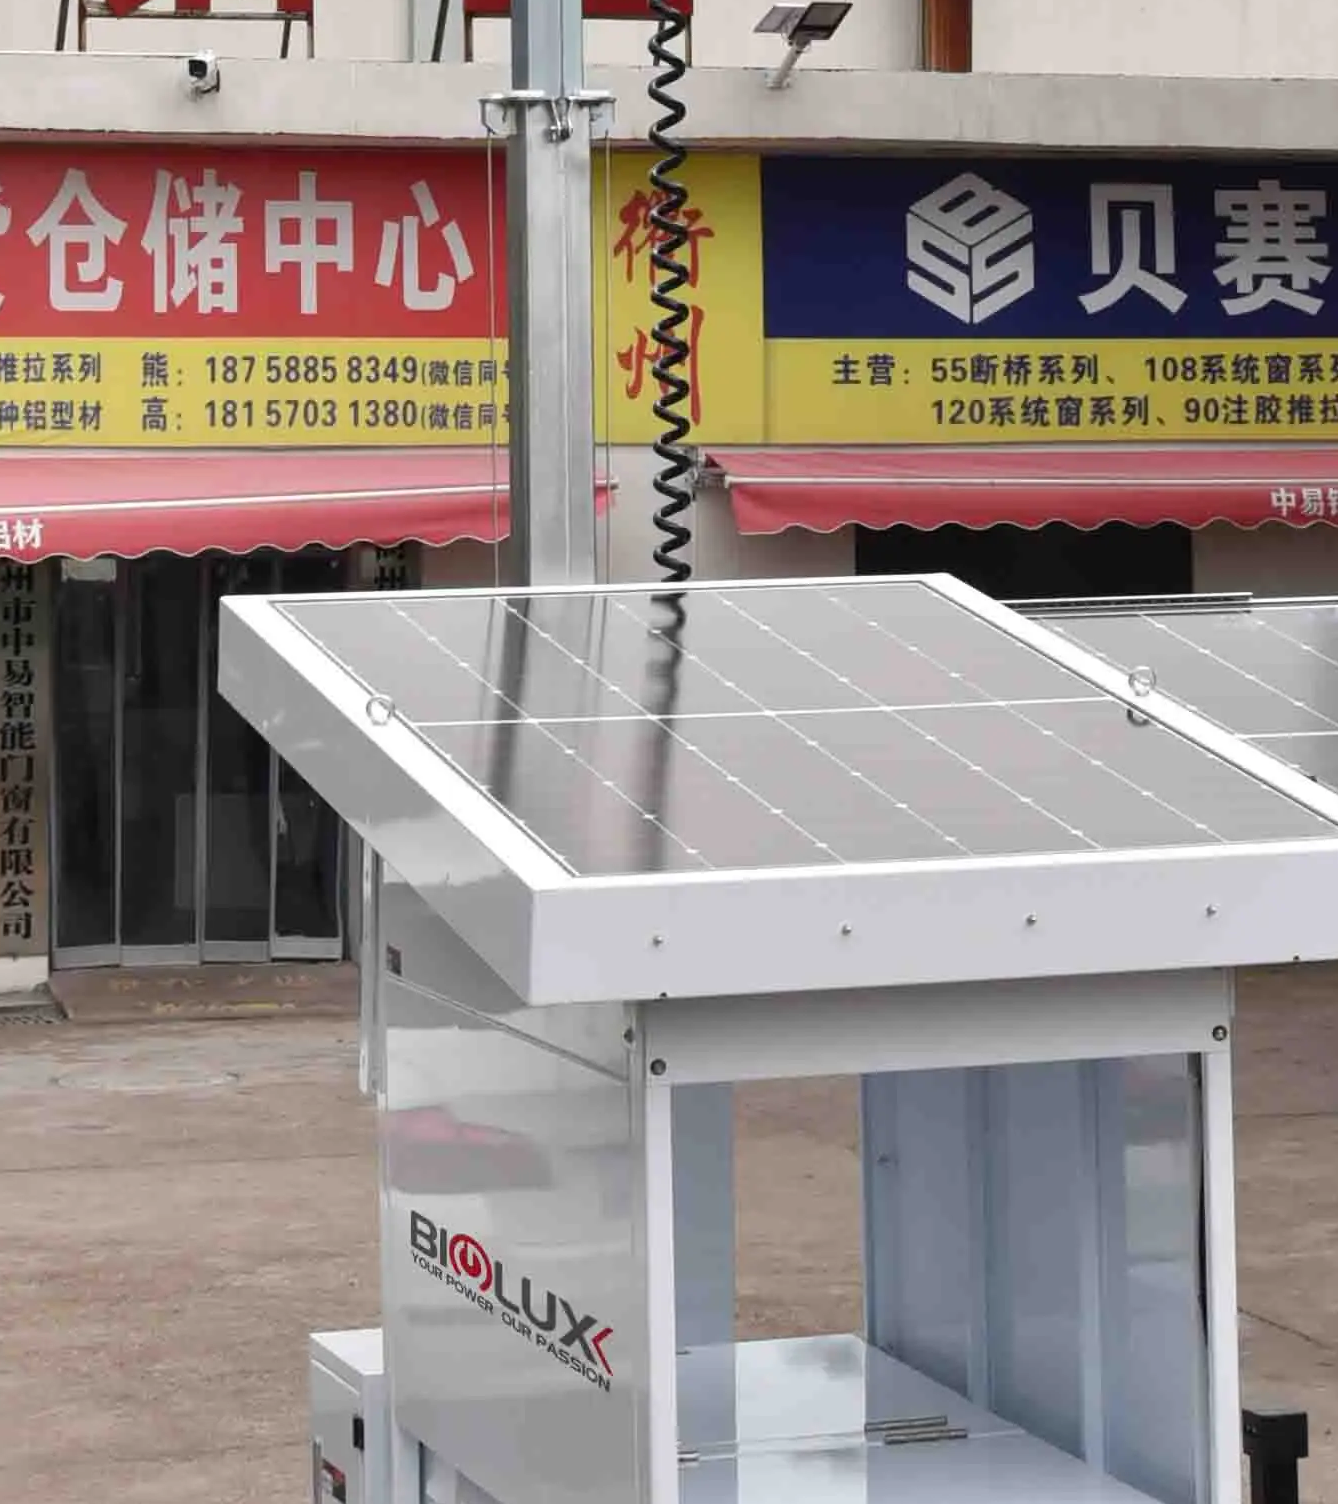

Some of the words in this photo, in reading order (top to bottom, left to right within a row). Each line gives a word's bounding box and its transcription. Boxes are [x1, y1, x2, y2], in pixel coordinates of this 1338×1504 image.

[205, 355, 256, 384] 187
[265, 355, 338, 384] 5885
[346, 355, 510, 386] 8349(微信同
[204, 399, 254, 428] 181
[265, 399, 338, 429] 5703
[347, 399, 510, 432] 1380(微信同
[411, 1250, 443, 1281] YOUR
[446, 1271, 494, 1315] POWER
[501, 1310, 532, 1341] OUR
[536, 1332, 611, 1393] PASSION
